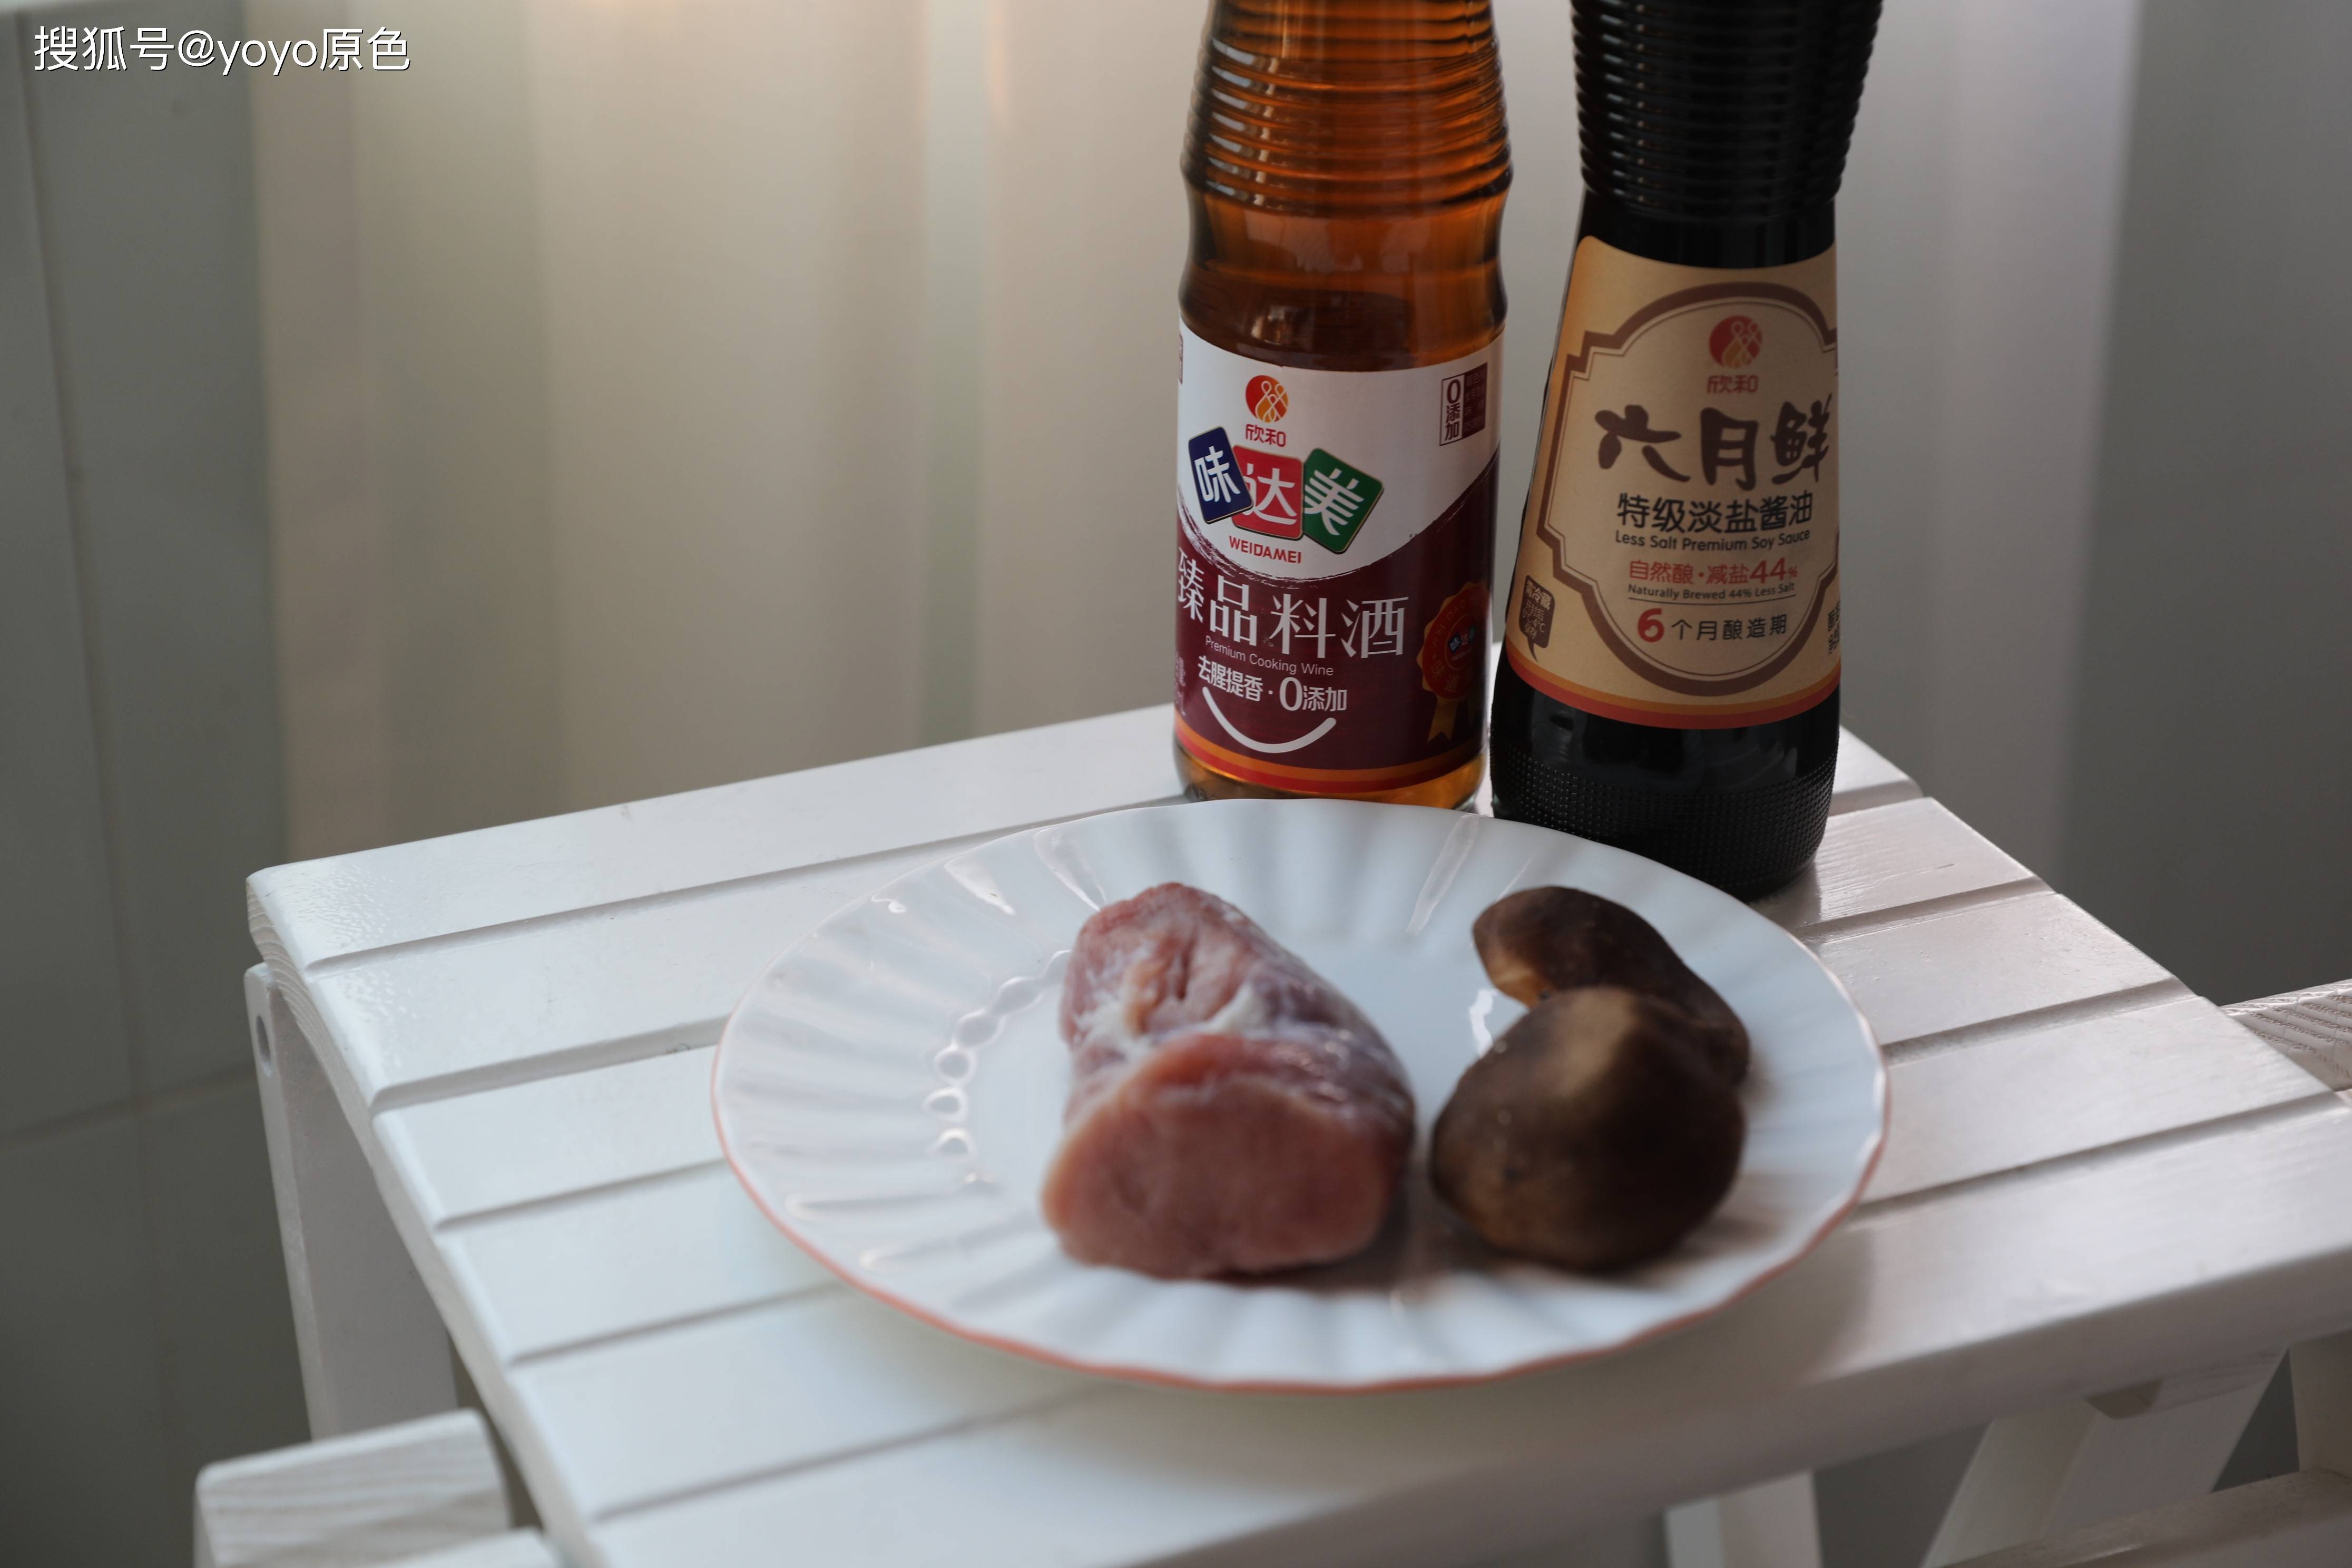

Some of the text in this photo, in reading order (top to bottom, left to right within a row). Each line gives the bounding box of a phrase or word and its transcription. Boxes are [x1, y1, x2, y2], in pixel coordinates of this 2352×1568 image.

[1707, 375, 1758, 394] 欣和
[1445, 379, 1461, 441] 0添加
[1246, 424, 1286, 447] 欣和
[1594, 393, 1832, 491] 六月鲜
[1194, 446, 1364, 535] 味达美
[1617, 490, 1813, 534] 特级淡盐酱油
[1229, 535, 1302, 564] WEIDAMEI
[1615, 528, 1811, 551] Less Salt Premium Soy Sauce
[1629, 557, 1798, 585] 自然酿·减盐44%
[1178, 546, 1409, 659] 臻品料酒
[1628, 582, 1795, 601] Naturally Brewed 44% Less Salt
[1636, 608, 1787, 642] 6个月酿造期
[1205, 635, 1334, 676] Premium Cooking Wine
[1197, 655, 1348, 712] 去腥提香·0添加
